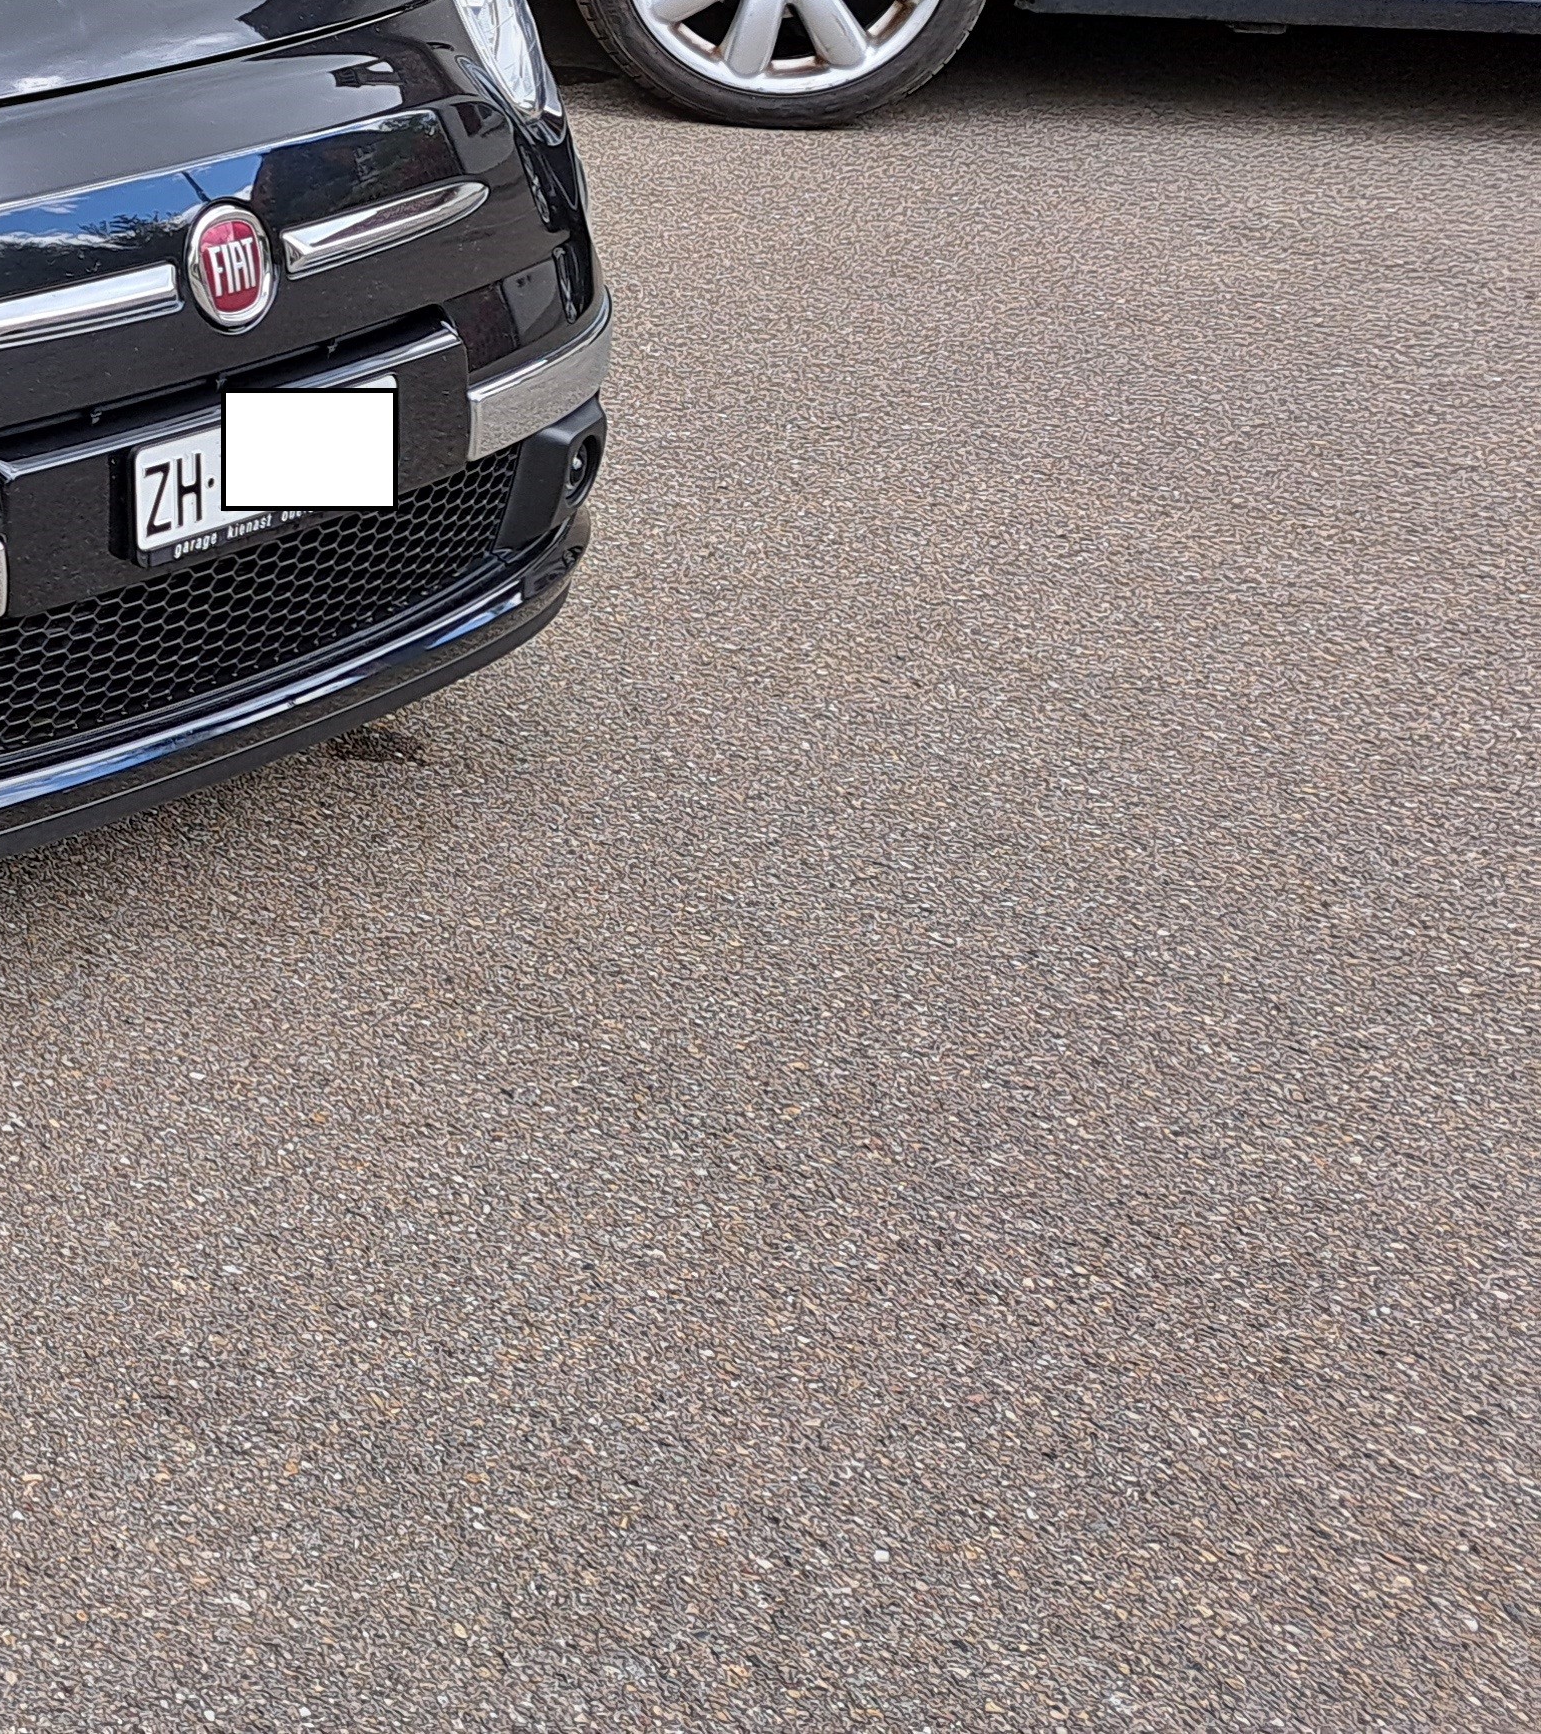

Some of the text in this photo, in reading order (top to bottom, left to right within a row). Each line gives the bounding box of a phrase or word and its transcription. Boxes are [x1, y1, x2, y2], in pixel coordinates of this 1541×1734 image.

[206, 236, 257, 298] FIAT
[173, 533, 218, 559] garage
[226, 512, 273, 539] kienast
